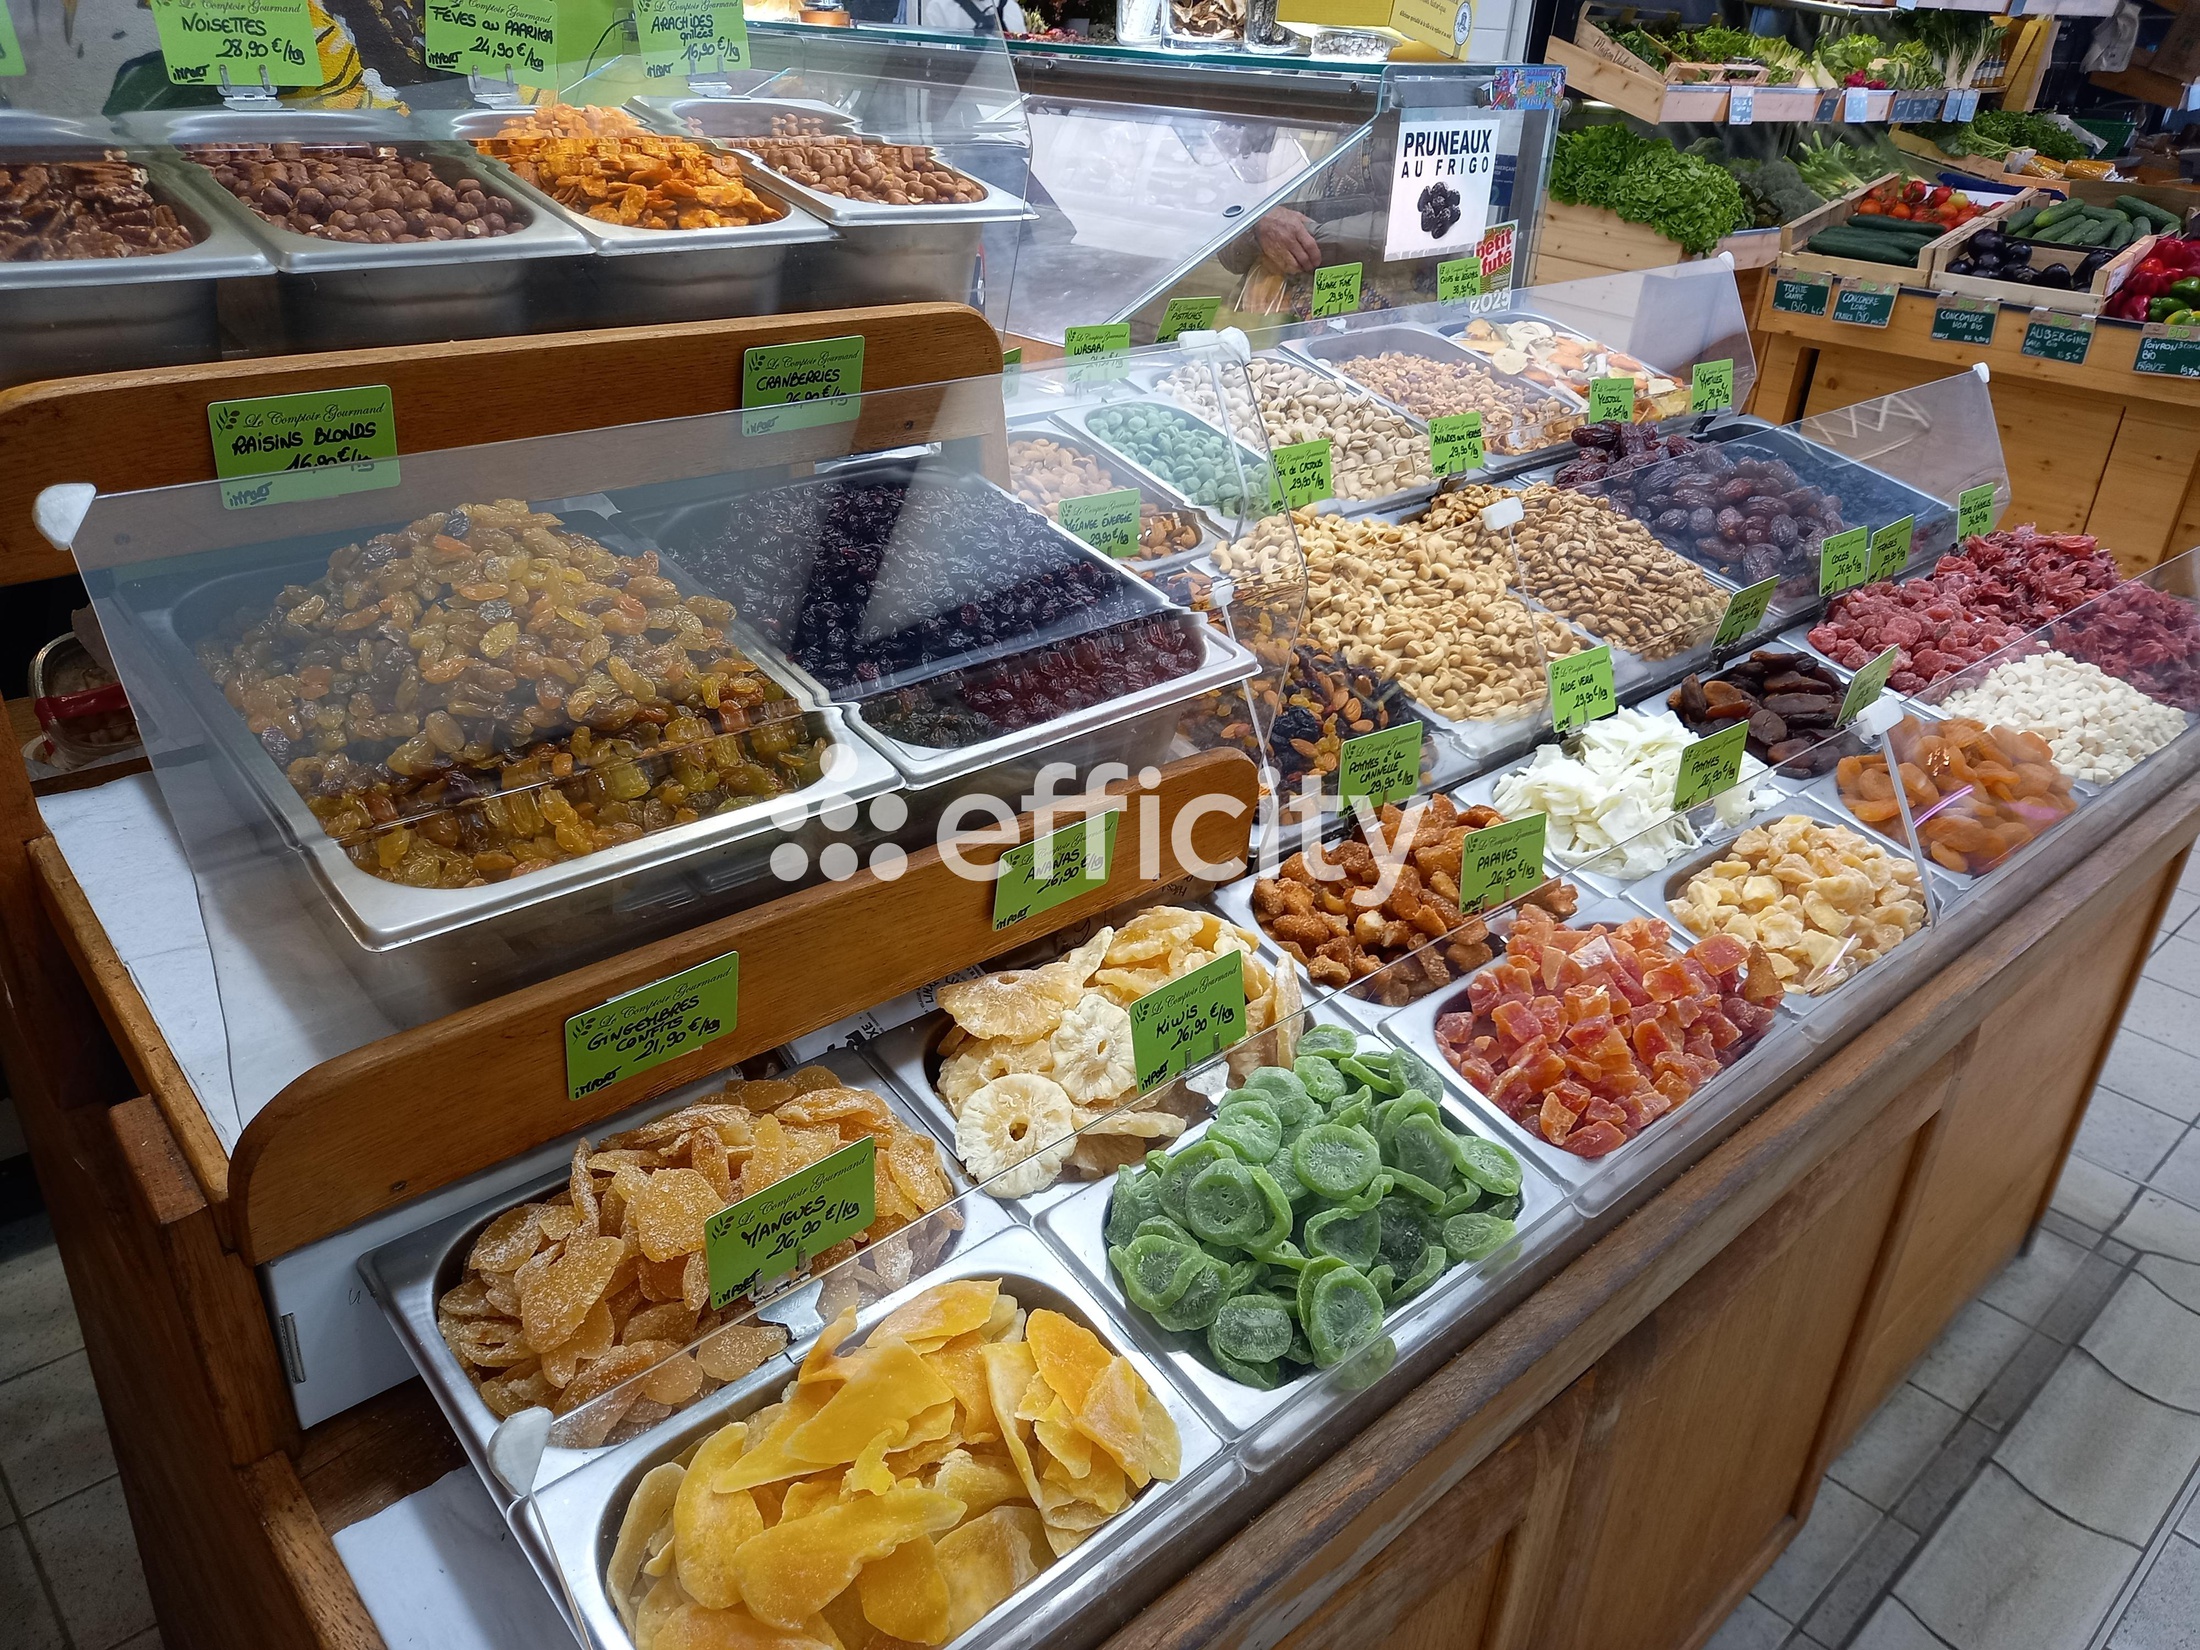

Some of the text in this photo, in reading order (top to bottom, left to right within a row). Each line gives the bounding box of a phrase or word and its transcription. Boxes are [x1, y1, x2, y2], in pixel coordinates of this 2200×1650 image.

[203, 0, 245, 13] Comptoir
[248, 0, 302, 14] Gourmand
[506, 3, 552, 24] Gourmand
[668, 0, 699, 13] Comptoir
[701, 0, 738, 11] Gourmand
[1403, 129, 1492, 158] PRUNEAUX
[1402, 156, 1490, 178] AU FRIGO
[1475, 228, 1513, 259] petit
[1481, 246, 1513, 277] futé
[782, 356, 818, 370] Comptoir
[818, 349, 860, 367] Gourmand
[243, 402, 385, 429] Le Comptoir Gourmand
[313, 421, 377, 446] BLONDS
[1359, 761, 1399, 784] CANNELLE
[1023, 848, 1081, 885] ANANAS
[1476, 847, 1518, 873] PAPAYES
[597, 966, 733, 1031] Le Comptoir Gourmand
[1164, 986, 1200, 1009] Comptoir
[1198, 963, 1239, 994] Gourmand
[736, 1152, 870, 1230] Le Comptoir Gourmand
[740, 1194, 828, 1249] MANGUES
